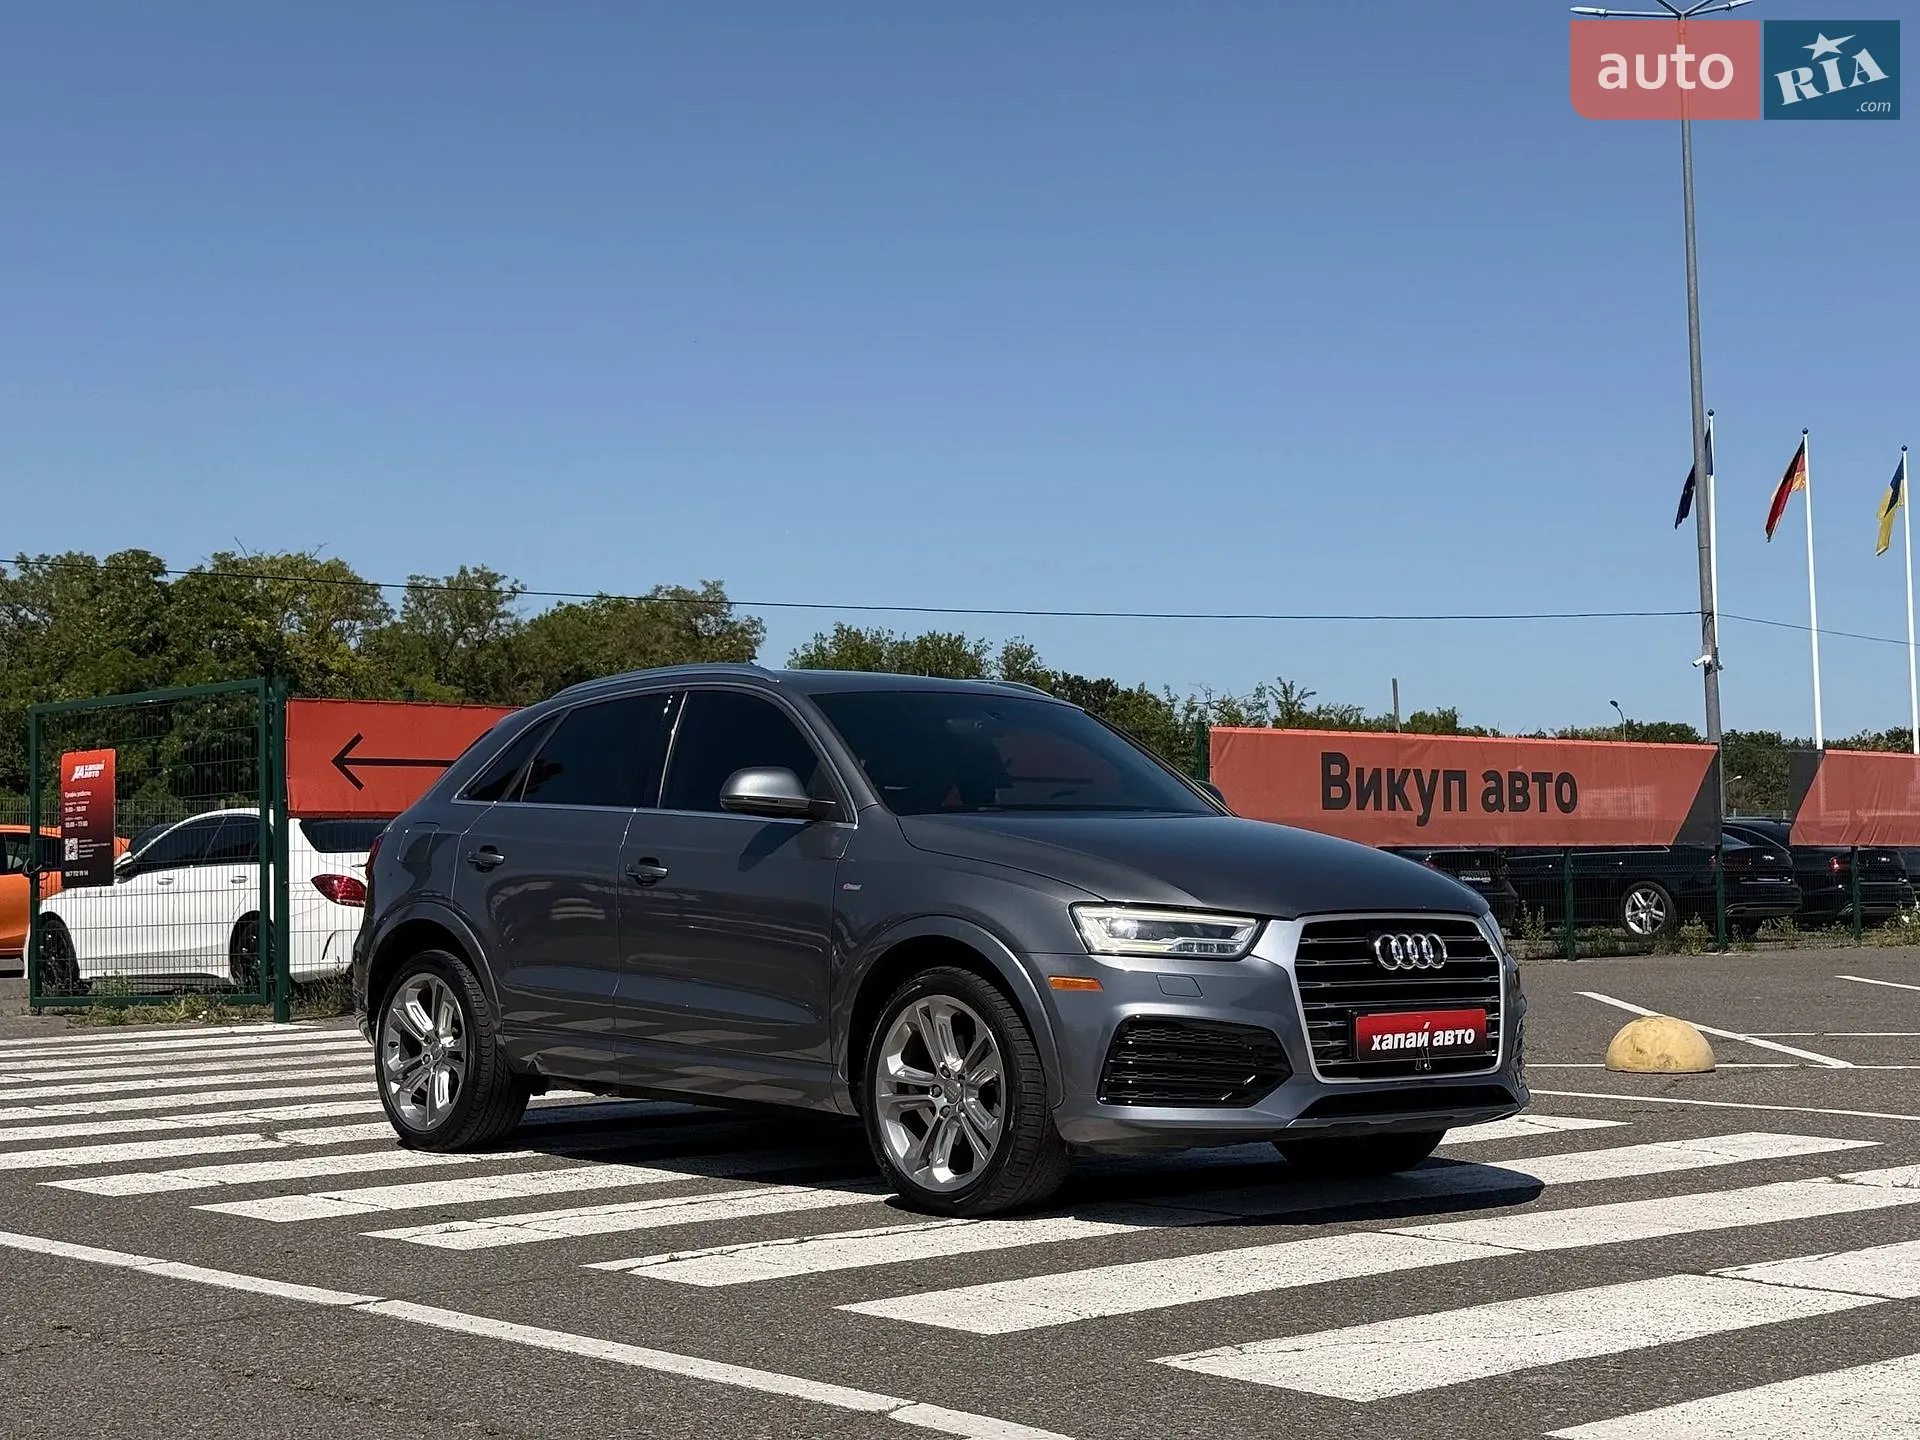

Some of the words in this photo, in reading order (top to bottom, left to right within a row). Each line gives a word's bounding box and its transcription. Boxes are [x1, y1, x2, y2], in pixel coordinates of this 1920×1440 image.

[1320, 751, 1469, 828] Викуп
[1480, 769, 1579, 815] авто
[1432, 1028, 1476, 1047] авто
